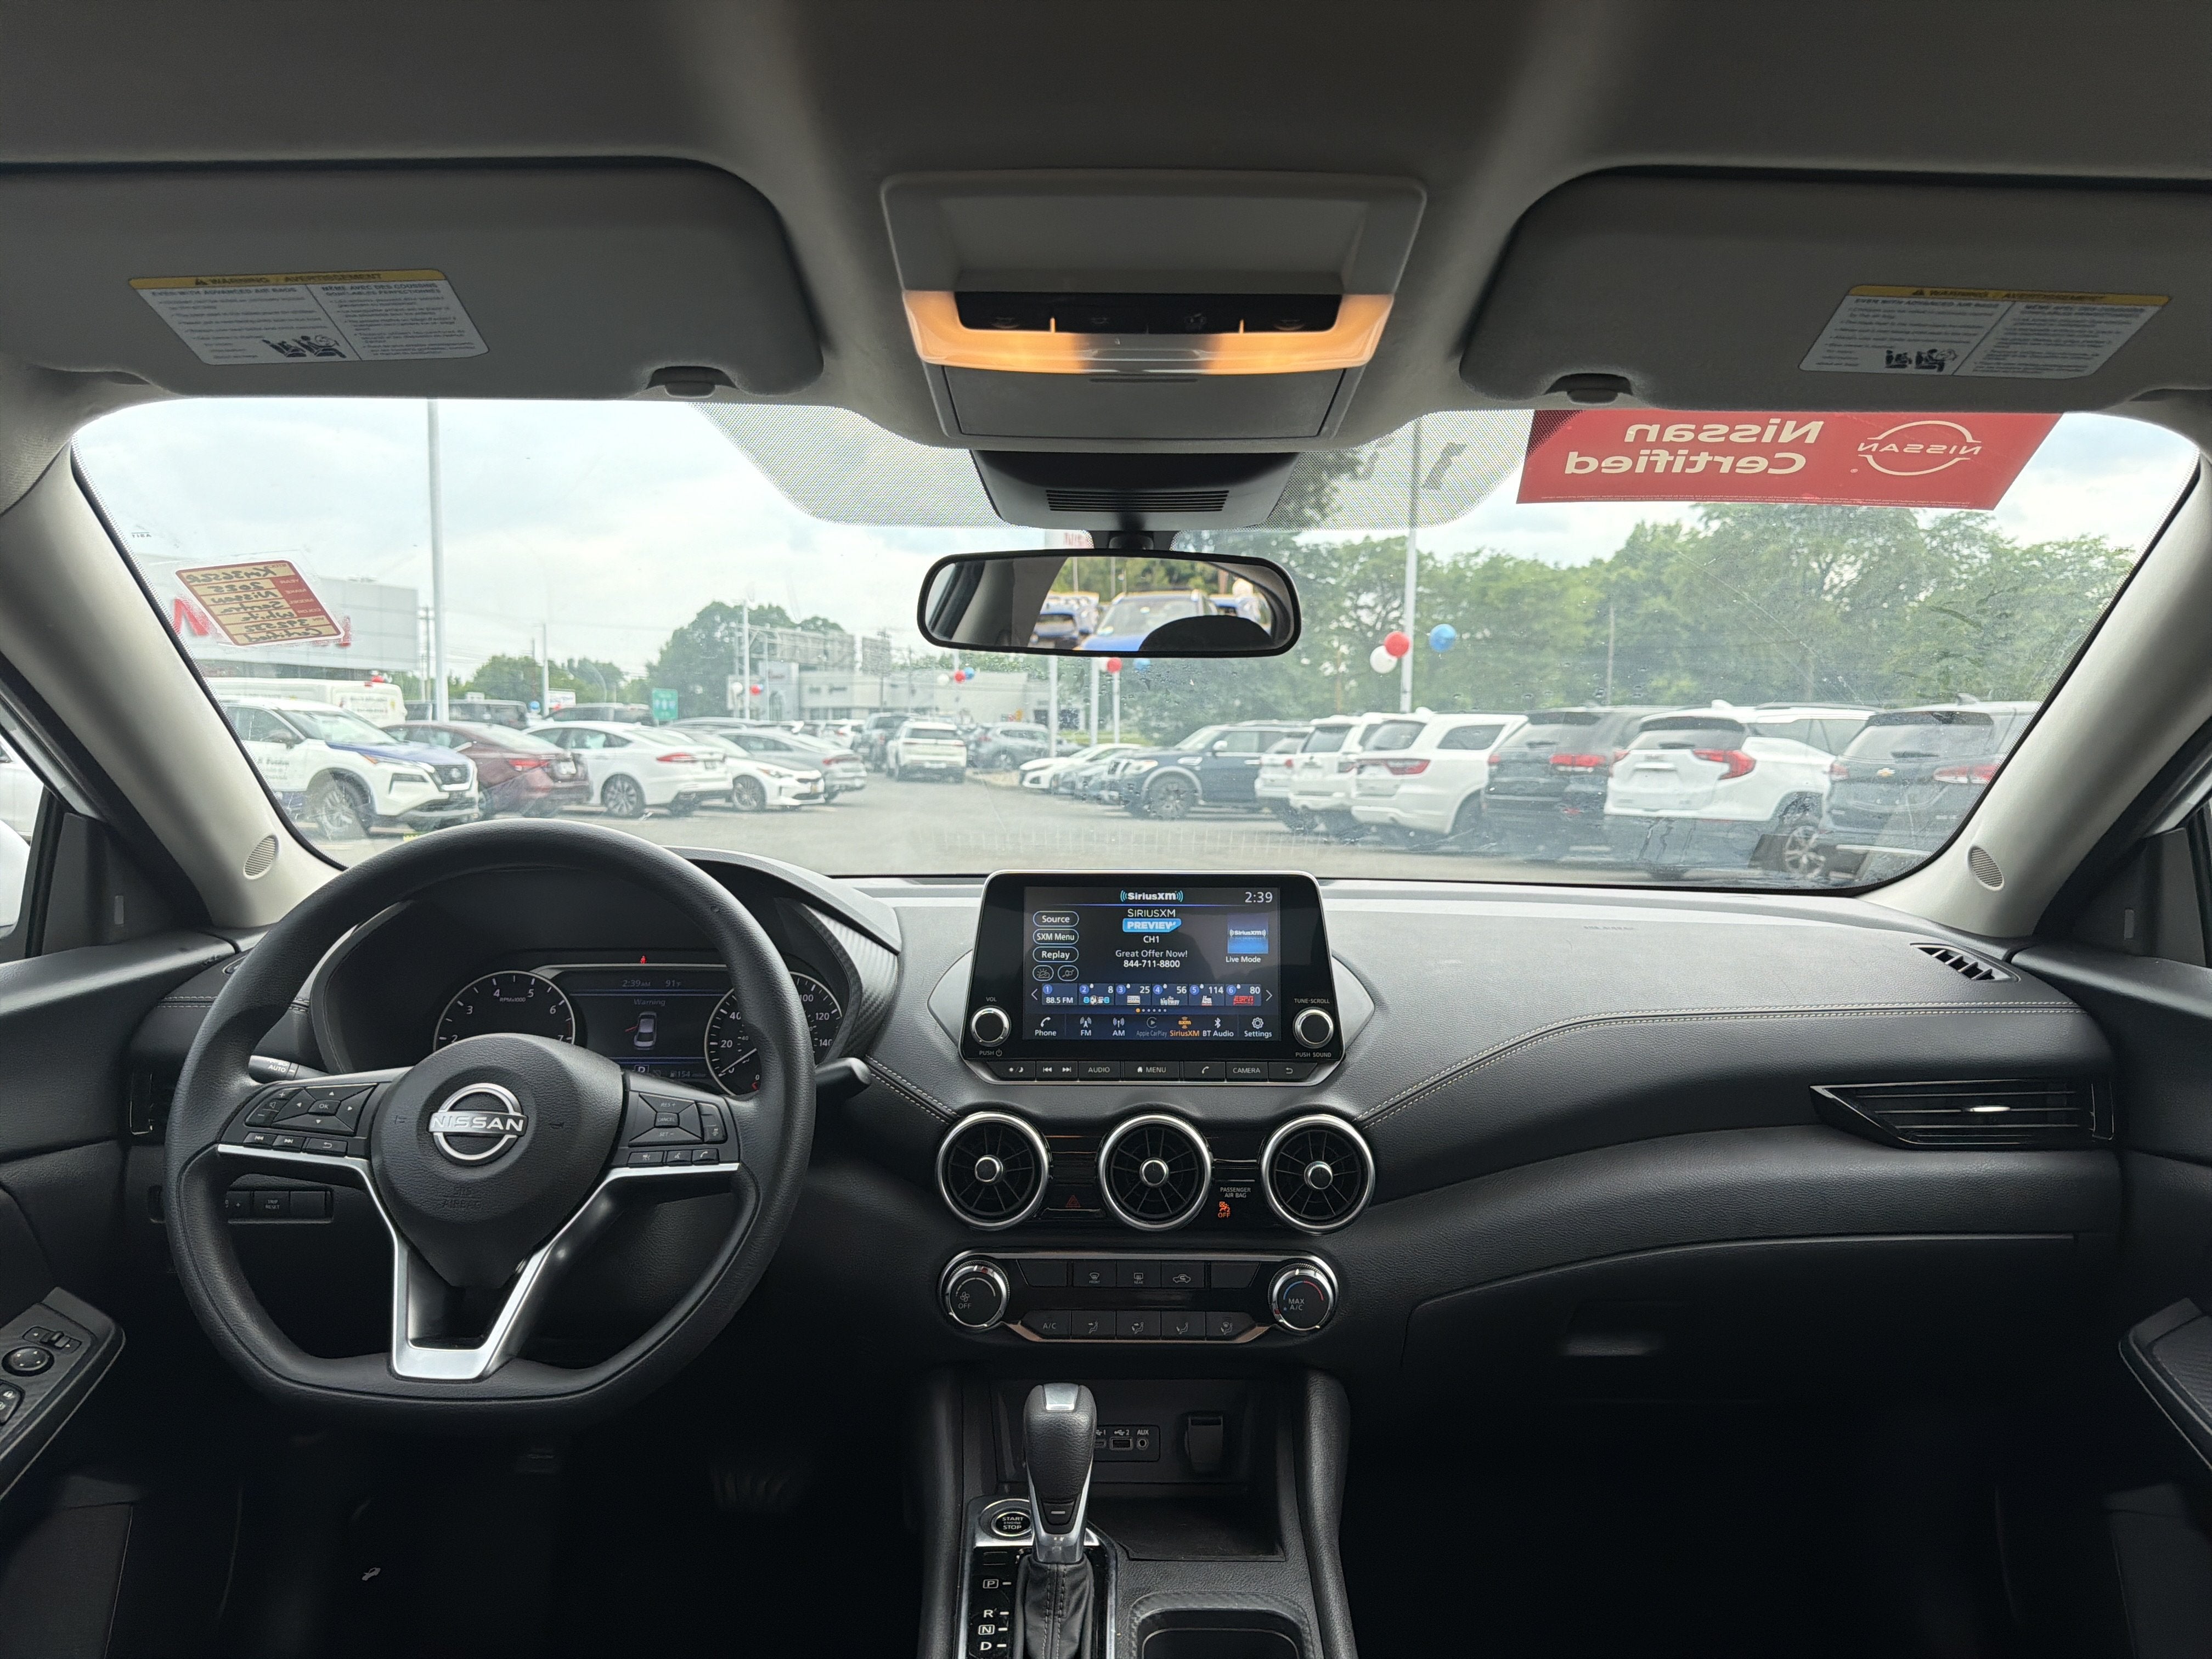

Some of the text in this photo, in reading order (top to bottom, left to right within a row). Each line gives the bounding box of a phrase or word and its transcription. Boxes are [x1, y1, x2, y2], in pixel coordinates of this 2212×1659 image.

[1245, 891, 1273, 904] 2:39
[1127, 909, 1176, 917] SIRIUSXM
[1042, 915, 1070, 923] Source
[1127, 921, 1176, 930] PREVIEW
[1054, 933, 1075, 941] Menu
[1143, 935, 1160, 944] CH1
[1041, 951, 1070, 960] Replay
[1116, 950, 1188, 958] Great Offer Now!
[1124, 960, 1180, 968] 844-711-8800
[493, 989, 500, 997] 4
[527, 989, 534, 998] 5
[634, 998, 665, 1007] Warning
[466, 1005, 473, 1014] 3
[549, 1005, 556, 1014] 6
[729, 1012, 741, 1020] 40
[815, 1012, 830, 1020] 120
[720, 1040, 733, 1048] 20
[268, 1064, 286, 1073] AUTO
[431, 1115, 524, 1132] NISSAN
[983, 1610, 994, 1618] R
[980, 1642, 992, 1651] D
